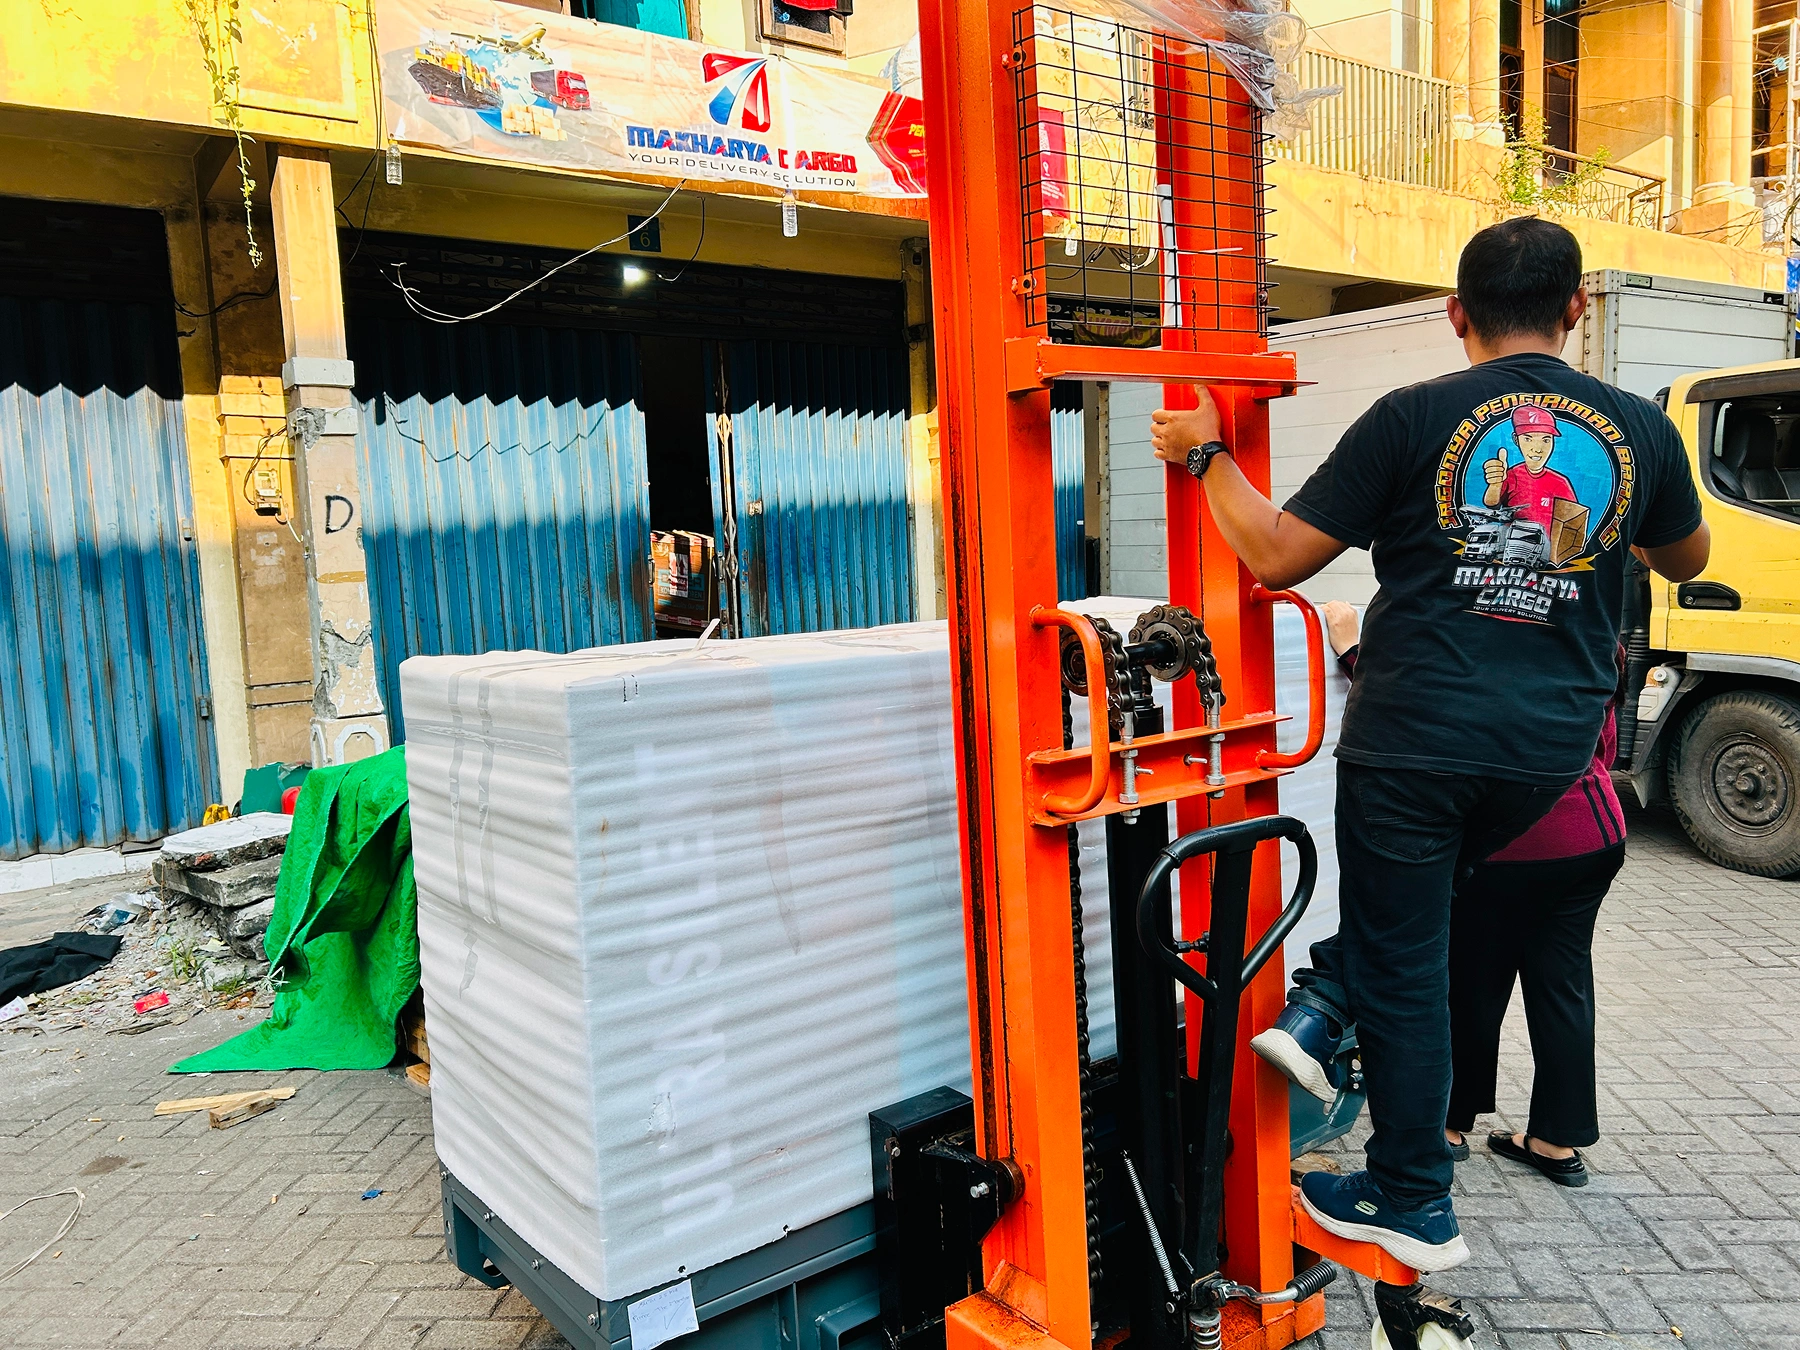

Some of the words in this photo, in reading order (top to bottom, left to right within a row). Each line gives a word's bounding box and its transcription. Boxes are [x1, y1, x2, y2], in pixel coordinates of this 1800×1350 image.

[626, 126, 773, 166] MAKHARYA
[778, 148, 858, 173] CARGO
[628, 152, 680, 166] YOUR
[685, 158, 768, 177] DELIVERY
[773, 172, 856, 187] SOLUTION
[1436, 419, 1478, 528] JAGONYA
[1474, 394, 1623, 443] PENGIRIMAN
[325, 494, 354, 534] D
[1453, 567, 1579, 600] MAKHARYA
[1476, 588, 1552, 614] CARGO
[1517, 611, 1548, 622] SOLUTION
